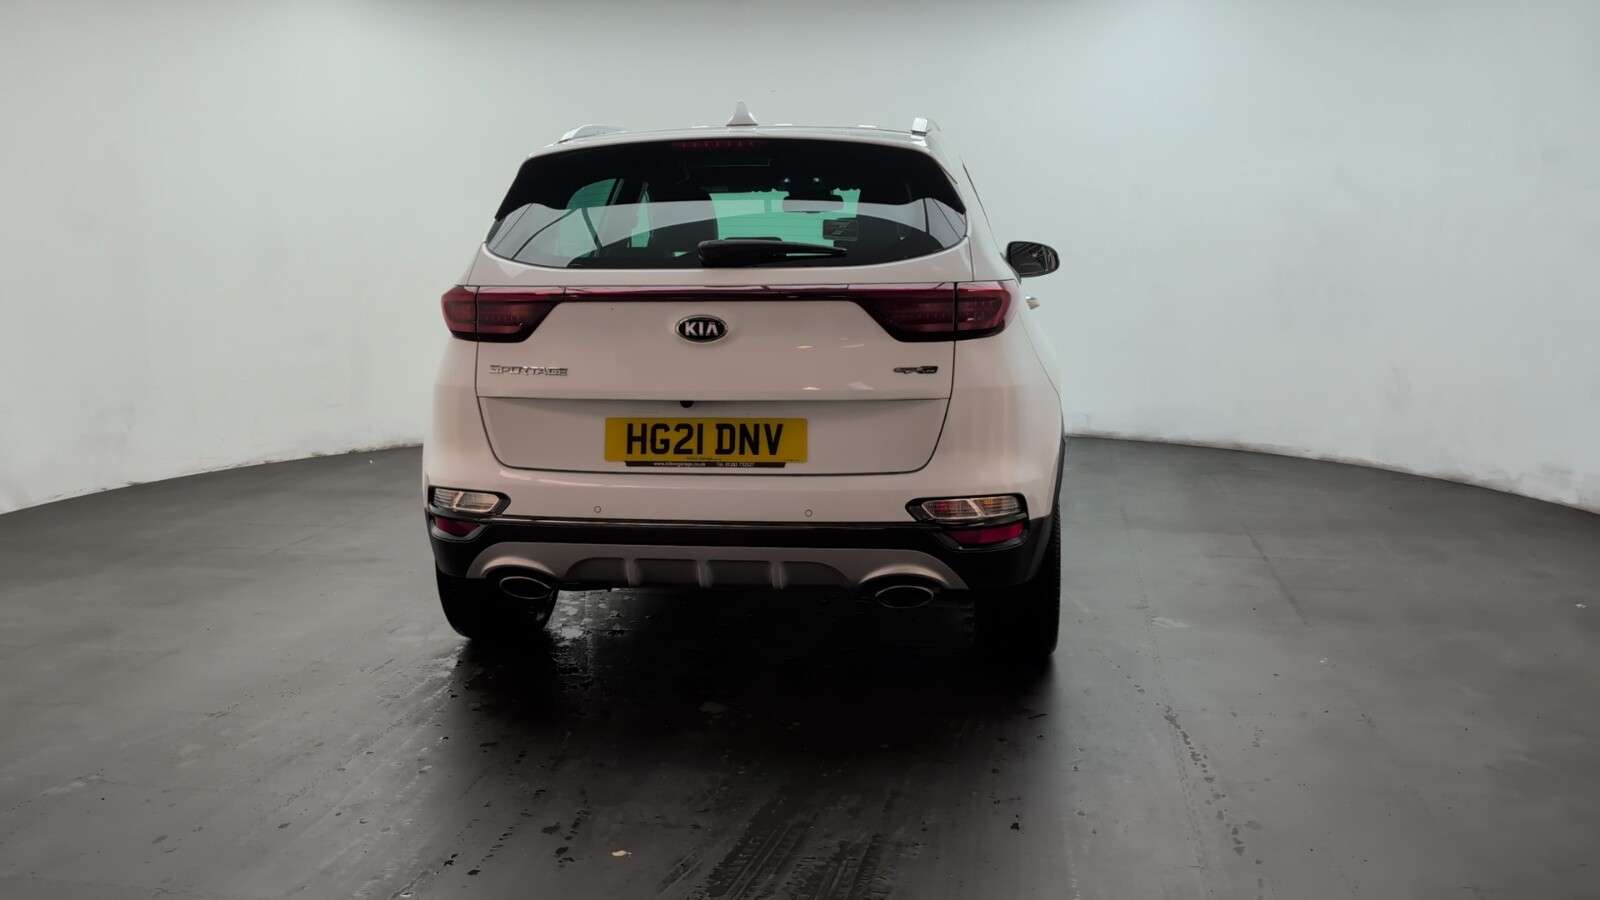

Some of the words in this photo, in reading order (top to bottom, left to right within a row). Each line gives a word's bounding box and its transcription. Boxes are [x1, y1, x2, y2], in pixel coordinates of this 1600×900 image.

[684, 321, 719, 337] KIA
[626, 422, 704, 455] HG21
[714, 423, 784, 456] DNV
